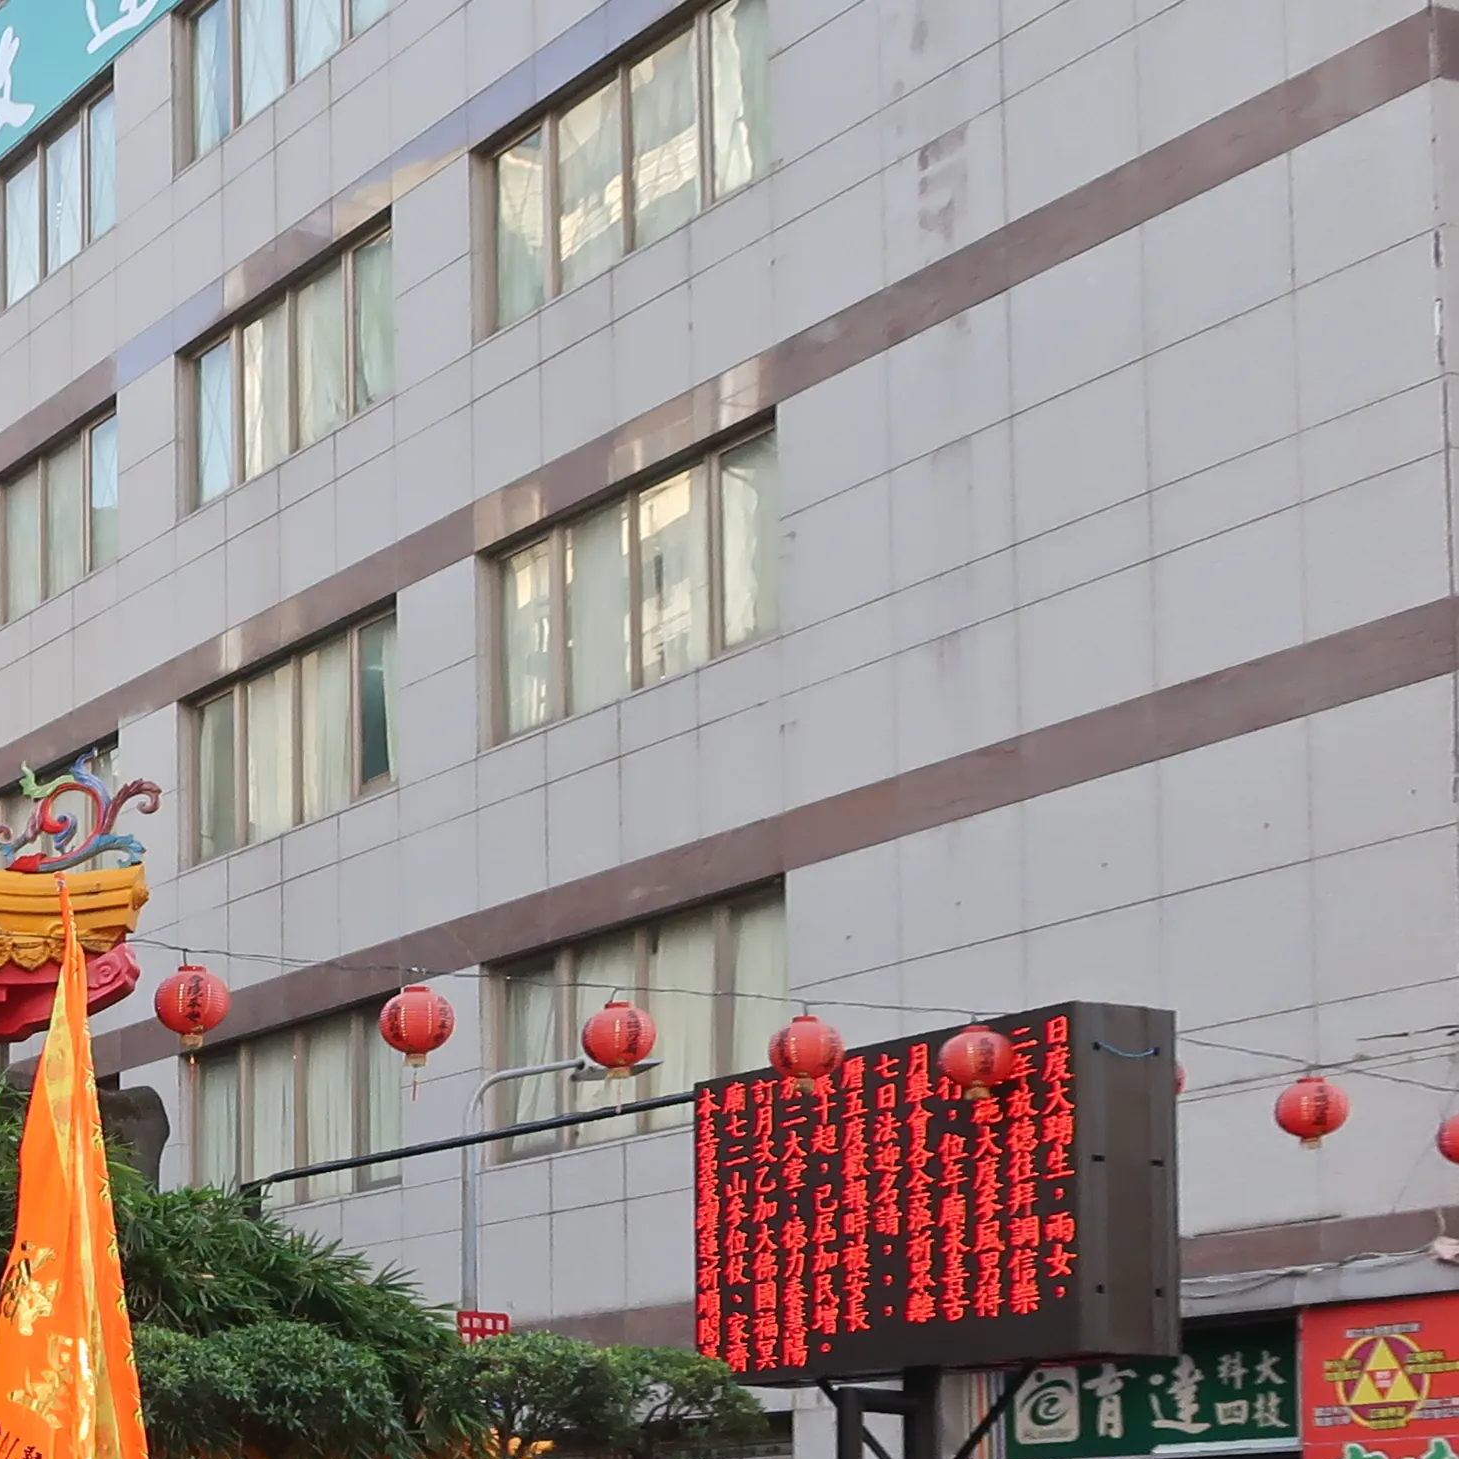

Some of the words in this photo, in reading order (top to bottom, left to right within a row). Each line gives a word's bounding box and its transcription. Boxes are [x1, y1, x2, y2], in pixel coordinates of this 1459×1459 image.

[1216, 1350, 1288, 1390] 科大
[1082, 1354, 1211, 1438] 育達
[1214, 1390, 1291, 1429] 四技
